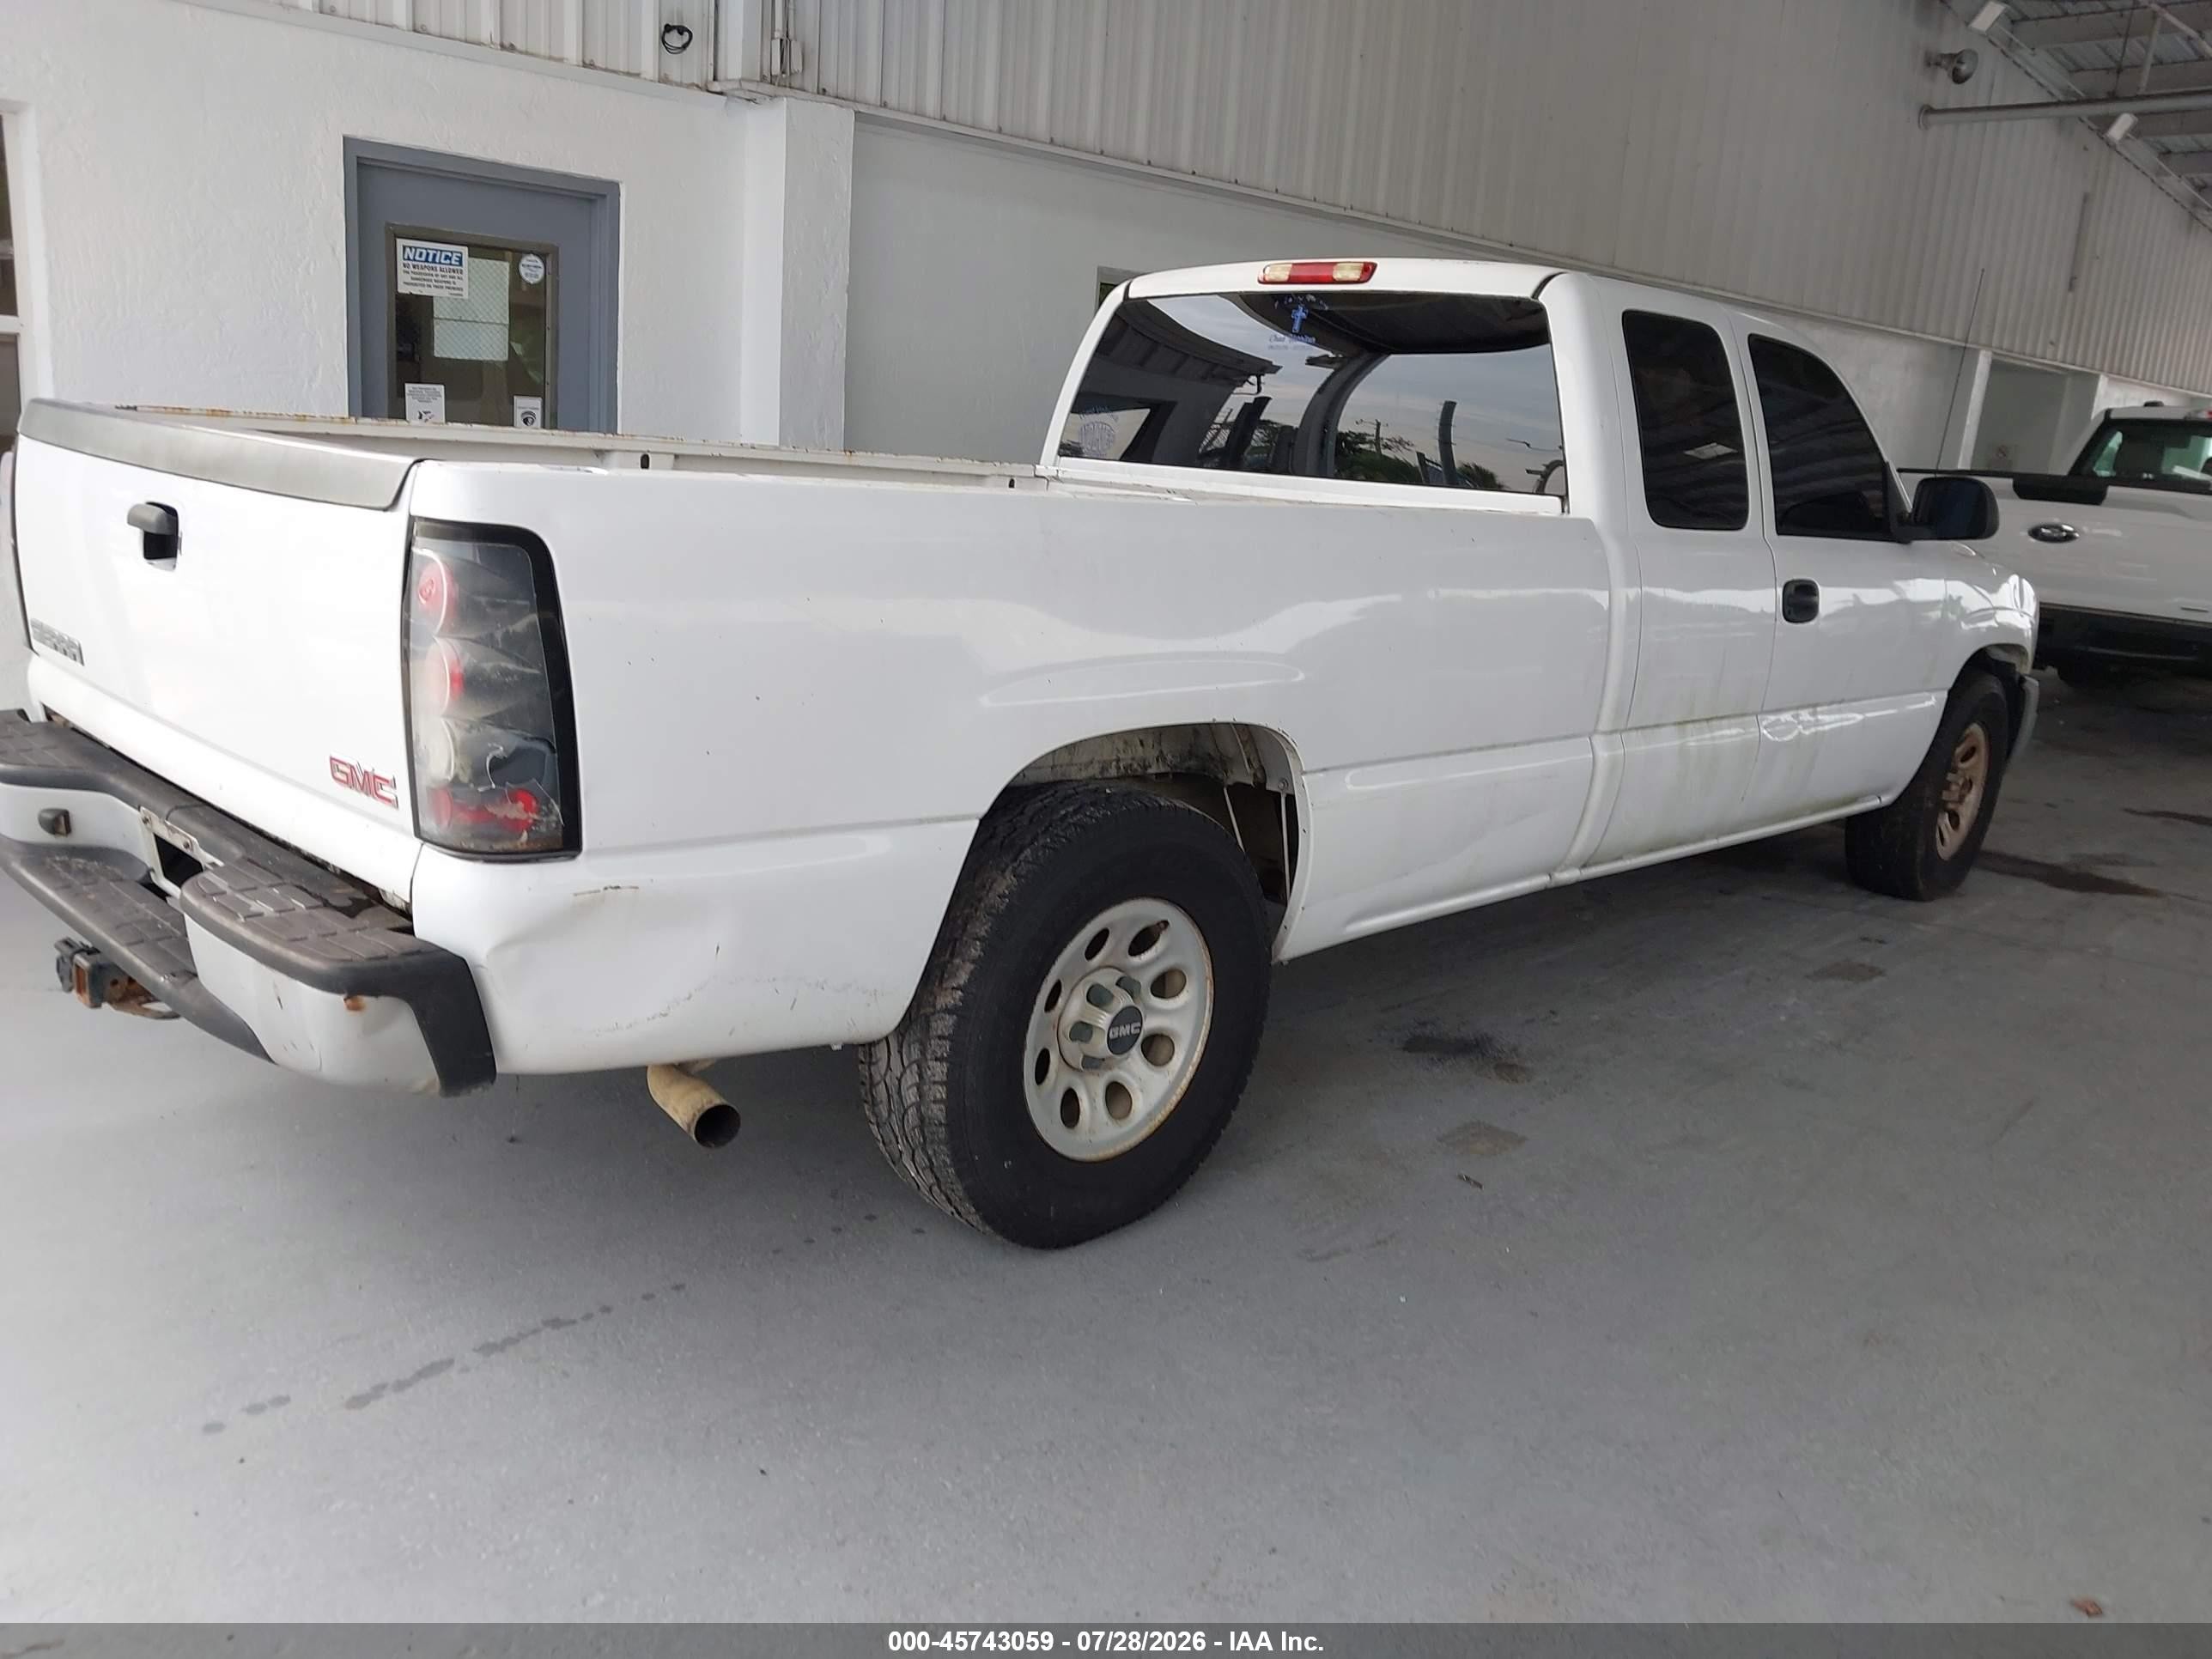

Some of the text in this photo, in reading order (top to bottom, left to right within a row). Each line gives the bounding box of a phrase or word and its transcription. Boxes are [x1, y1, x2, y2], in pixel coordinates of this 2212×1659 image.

[404, 246, 462, 265] NOTICE
[411, 264, 438, 272] WEAPONS
[330, 755, 399, 810] GMC
[1109, 1022, 1141, 1041] GMC
